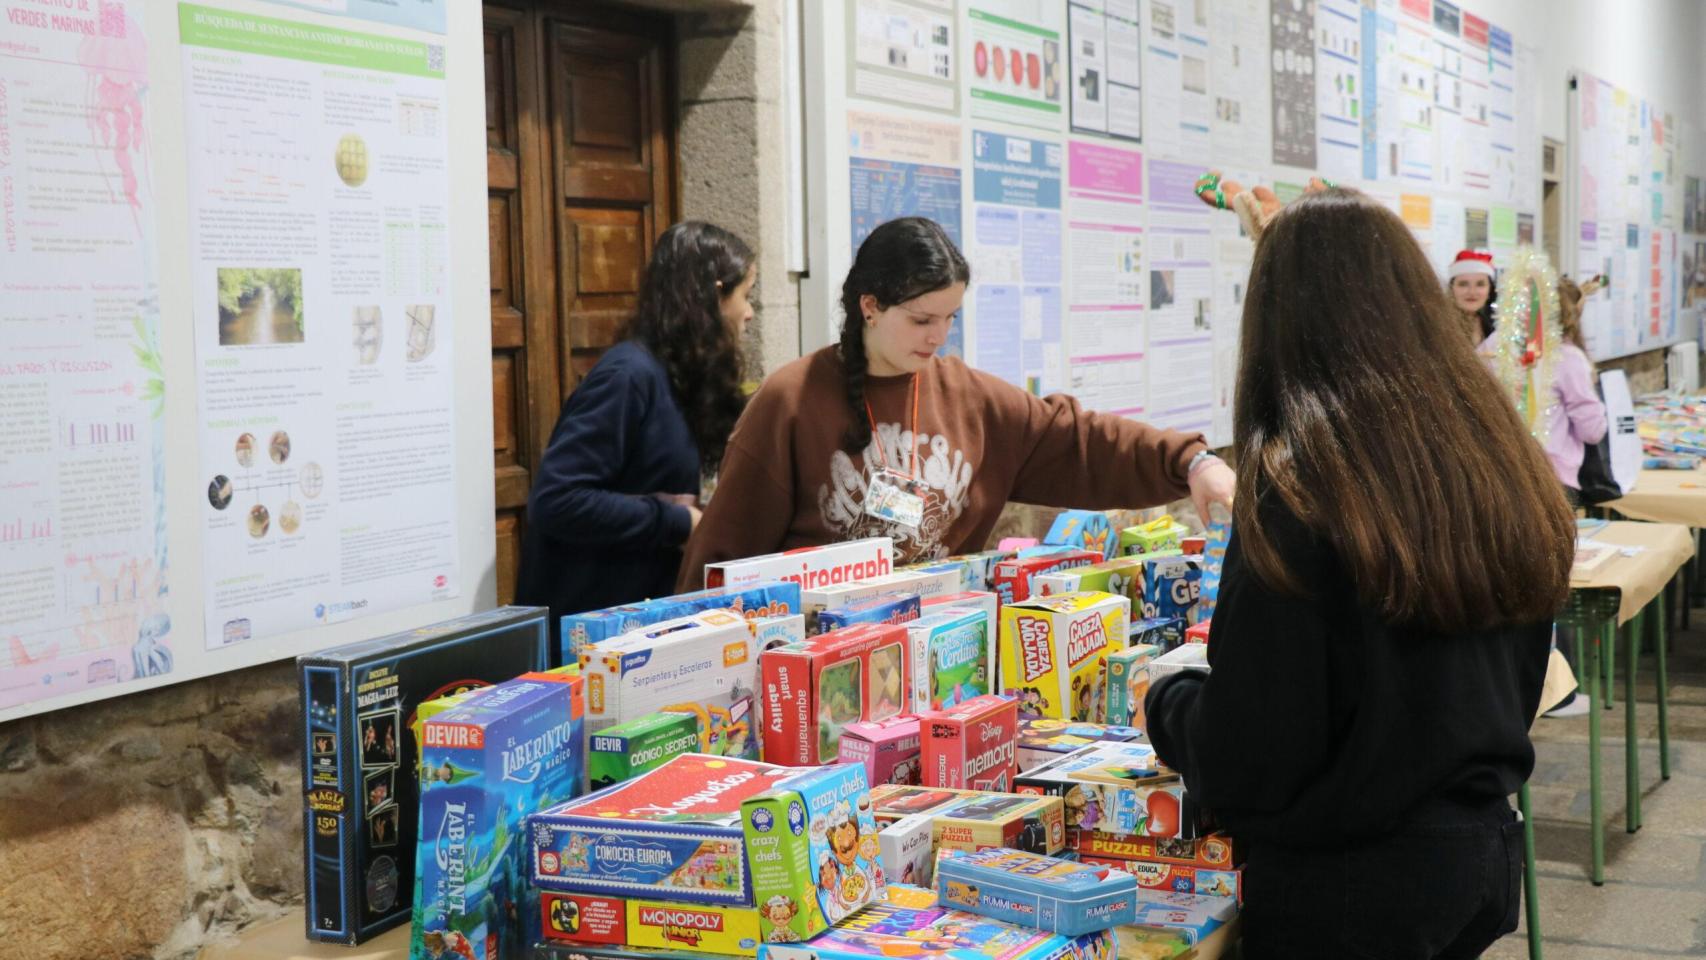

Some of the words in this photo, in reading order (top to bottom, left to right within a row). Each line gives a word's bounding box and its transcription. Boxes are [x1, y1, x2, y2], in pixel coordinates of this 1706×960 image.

[7, 7, 50, 29] VERDES
[51, 15, 97, 36] MARINAS
[915, 580, 944, 596] Puzzle
[1070, 613, 1101, 643] CABEZA
[941, 642, 979, 669] Cerditos
[1020, 618, 1041, 681] MOJADA
[1034, 621, 1052, 672] CABEZA
[1068, 628, 1106, 665] MOJADA
[633, 670, 671, 688] Serpientes
[679, 660, 713, 676] Escaleras
[778, 665, 793, 700] smart
[357, 691, 380, 708] MAGIA
[385, 685, 399, 698] LUZ
[768, 683, 784, 733] ability
[425, 724, 468, 745] DEVIR
[796, 689, 809, 764] aquamarine
[979, 722, 1003, 743] Disney
[502, 720, 571, 783] LABERINTO
[507, 736, 516, 748] EL
[595, 737, 622, 752] DEVIR
[664, 733, 697, 755] SECRETO
[841, 738, 870, 753] HELLO
[897, 735, 920, 751] HELL
[841, 748, 870, 762] KITTY
[965, 735, 1015, 780] memory
[308, 791, 344, 806] MAGIA
[811, 787, 838, 811] crazy
[840, 770, 865, 798] chefs
[316, 816, 337, 829] 150
[467, 813, 476, 826] EL
[919, 830, 929, 844] Play
[940, 833, 973, 843] PUZZLES
[942, 826, 947, 834] 2
[948, 826, 973, 836] SUPER
[751, 836, 780, 848] crazy
[1092, 839, 1151, 857] PUZZLE
[595, 844, 635, 863] CONOCER
[637, 848, 673, 865] EUROPA
[755, 848, 782, 862] chefs
[1137, 864, 1158, 874] EDUCA
[983, 896, 1010, 911] RUMMI
[1010, 902, 1033, 914] CLASIC
[1086, 903, 1109, 918] RUMMI
[1108, 901, 1128, 912] CLASIC
[642, 909, 720, 929] MONOPOLY
